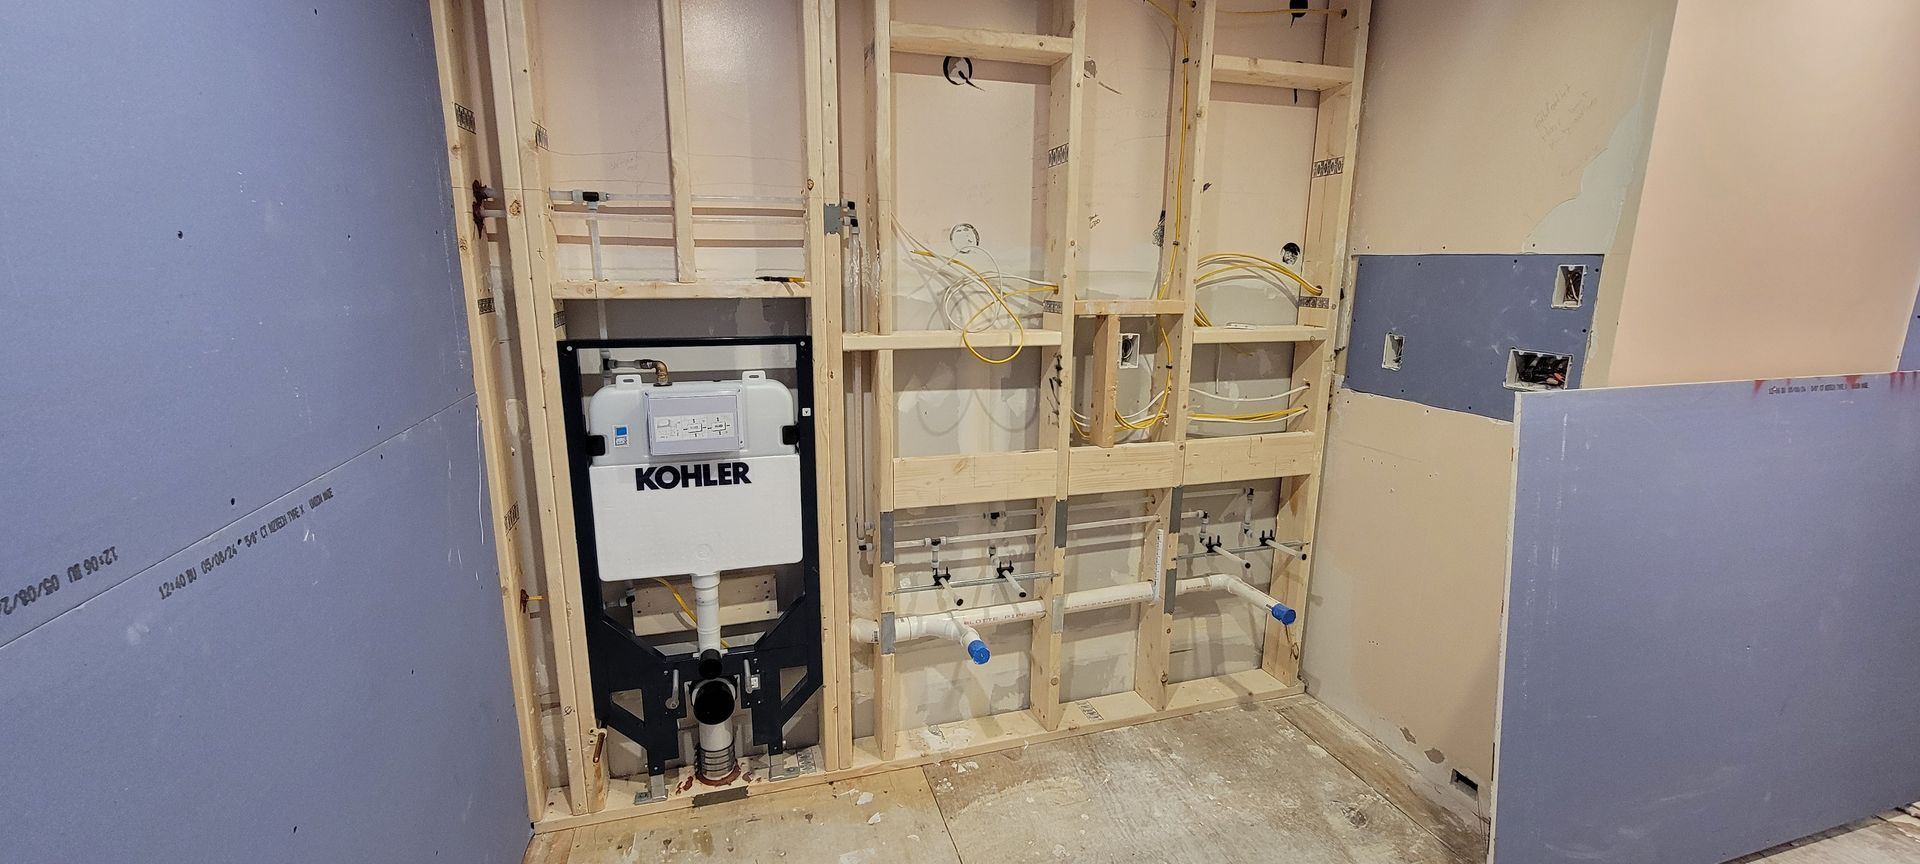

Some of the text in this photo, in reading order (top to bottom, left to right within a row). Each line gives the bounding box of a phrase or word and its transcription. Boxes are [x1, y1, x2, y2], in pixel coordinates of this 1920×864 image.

[635, 462, 752, 491] KOHLER
[83, 546, 118, 575] 12:06
[159, 574, 187, 600] 12:40
[200, 544, 237, 575] 05/08/24
[0, 574, 60, 615] 05/08/2
